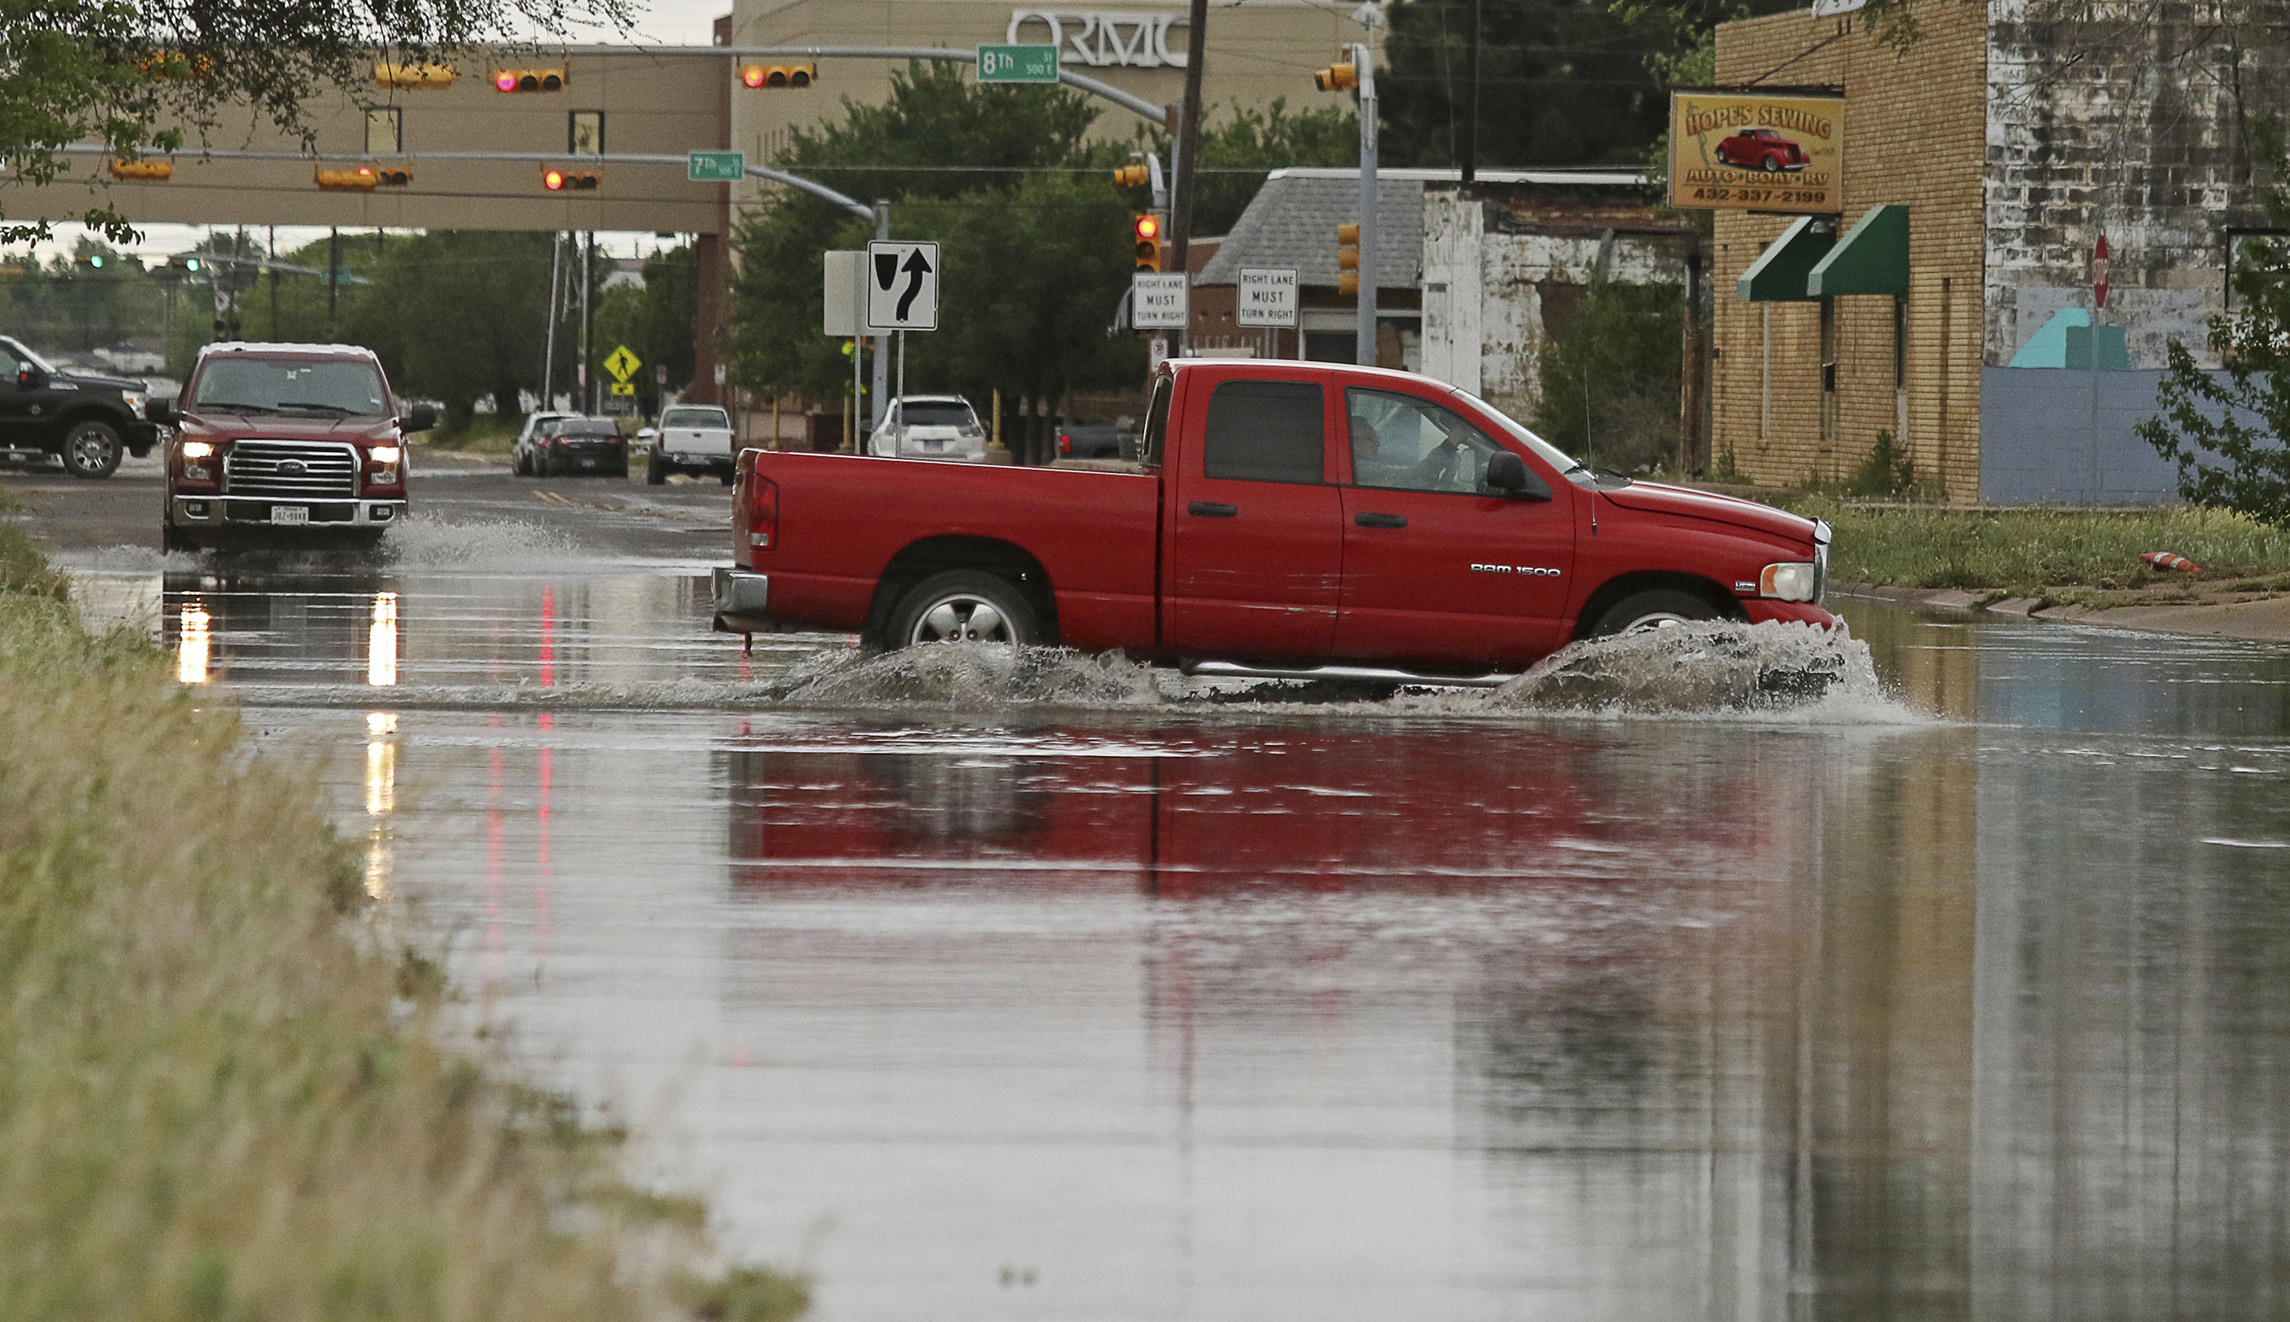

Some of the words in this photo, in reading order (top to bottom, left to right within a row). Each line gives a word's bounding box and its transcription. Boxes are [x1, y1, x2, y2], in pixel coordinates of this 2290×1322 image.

[1006, 10, 1189, 67] ORMC
[1686, 105, 1753, 136] HOPE'S
[1758, 103, 1832, 140] SEWING
[1686, 169, 1737, 183] AUTO
[1744, 171, 1794, 186] BOAT
[1801, 173, 1830, 186] RV
[1694, 188, 1826, 203] 432-337-2199
[1137, 280, 1161, 289] RIGHT
[1162, 280, 1184, 289] LANE
[1243, 274, 1268, 285] RIGHT
[1271, 275, 1294, 286] LANE
[1146, 295, 1176, 306] MUST
[1252, 291, 1284, 303] MUST
[1137, 311, 1158, 321] TURN
[1161, 311, 1184, 321] RIGHT
[1241, 309, 1265, 319] TURN
[1268, 309, 1293, 320] RIGHT
[1470, 563, 1512, 574] RAM
[1516, 566, 1562, 577] 1500
